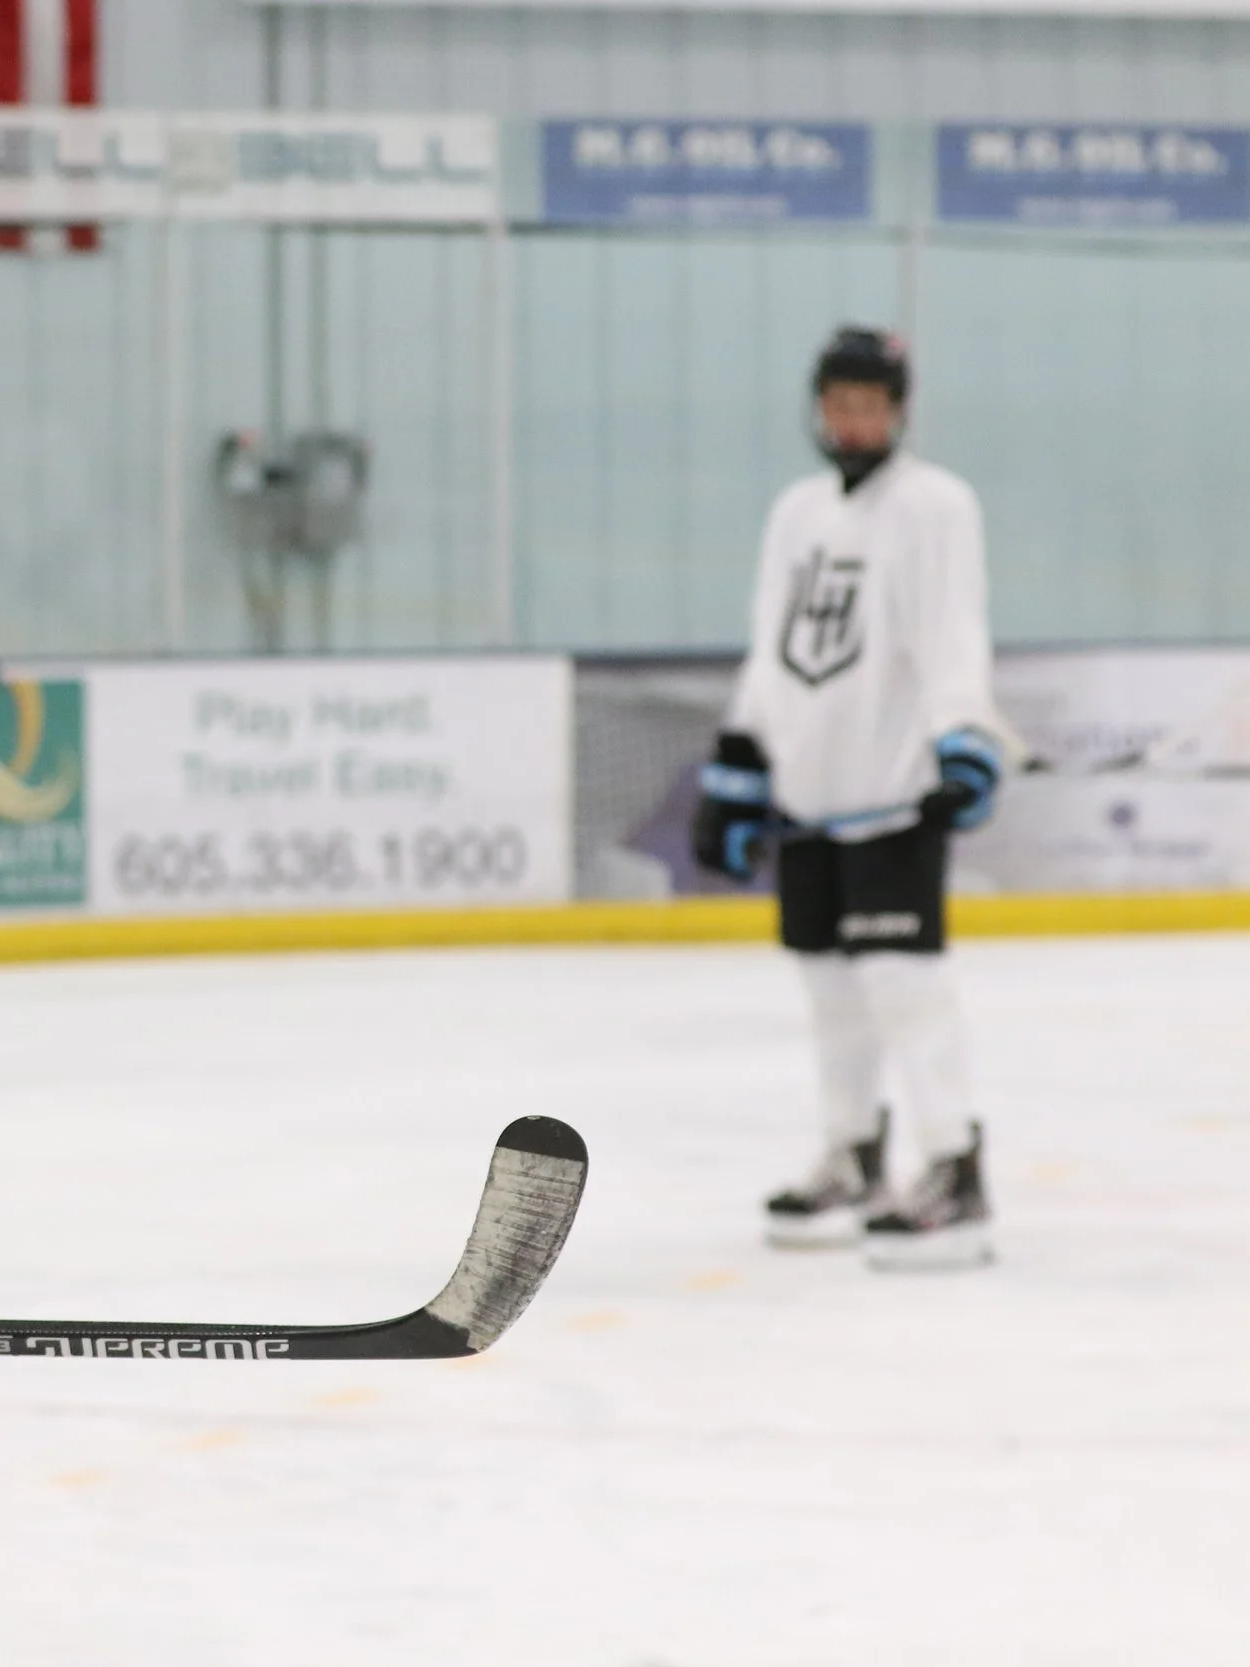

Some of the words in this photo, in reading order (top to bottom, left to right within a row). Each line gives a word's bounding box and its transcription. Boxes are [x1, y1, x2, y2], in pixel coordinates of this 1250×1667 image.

[194, 690, 293, 742] Play
[178, 750, 320, 799] Travel
[112, 824, 531, 897] 605.336.1900
[24, 1335, 291, 1361] SUPREME
